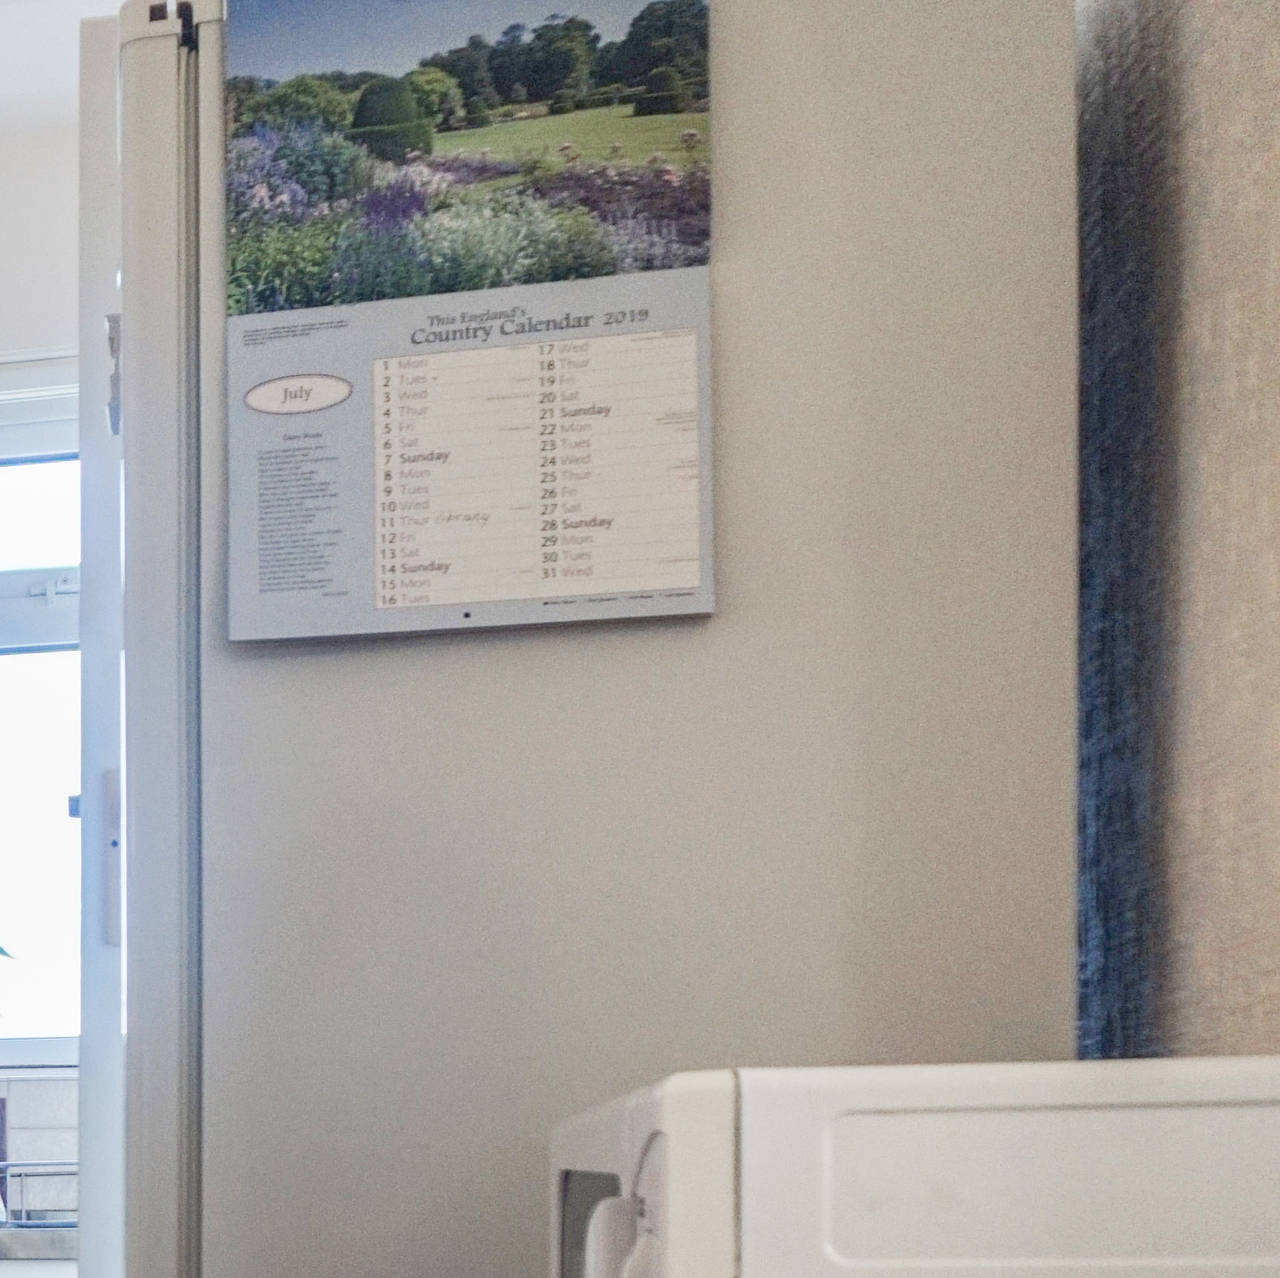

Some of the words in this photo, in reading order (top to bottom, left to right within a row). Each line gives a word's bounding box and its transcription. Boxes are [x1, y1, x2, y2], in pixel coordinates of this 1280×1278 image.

[427, 315, 456, 327] This
[461, 306, 527, 325] England's
[410, 323, 493, 345] Country
[500, 313, 594, 336] Calendar
[602, 309, 649, 326] 2019
[538, 344, 555, 355] 17
[383, 361, 389, 371] 1
[538, 360, 555, 371] 18
[383, 376, 391, 387] 2
[538, 376, 555, 387] 19
[281, 386, 313, 404] July
[383, 392, 391, 403] 3
[539, 392, 556, 404] 20
[383, 408, 391, 418] 4
[539, 408, 554, 419] 21
[559, 404, 612, 418] Sunday
[383, 423, 392, 434] 5
[539, 424, 557, 435] 22
[383, 439, 392, 450] 6
[540, 440, 557, 451] 23
[384, 454, 392, 465] 7
[399, 451, 450, 464] Sunday
[540, 456, 557, 467] 24
[384, 470, 392, 481] 8
[540, 472, 557, 483] 25
[384, 486, 392, 496] 9
[540, 488, 557, 499] 26
[381, 502, 397, 513] 10
[541, 503, 558, 515] 27
[381, 517, 395, 528] 11
[541, 519, 559, 531] 28
[561, 516, 614, 530] Sunday
[381, 533, 397, 544] 12
[541, 535, 558, 547] 29
[381, 549, 396, 560] 13
[541, 551, 558, 563] 30
[381, 564, 396, 575] 14
[400, 560, 451, 574] Sunday
[542, 567, 557, 580] 31
[381, 580, 396, 591] 15
[381, 595, 397, 606] 16
